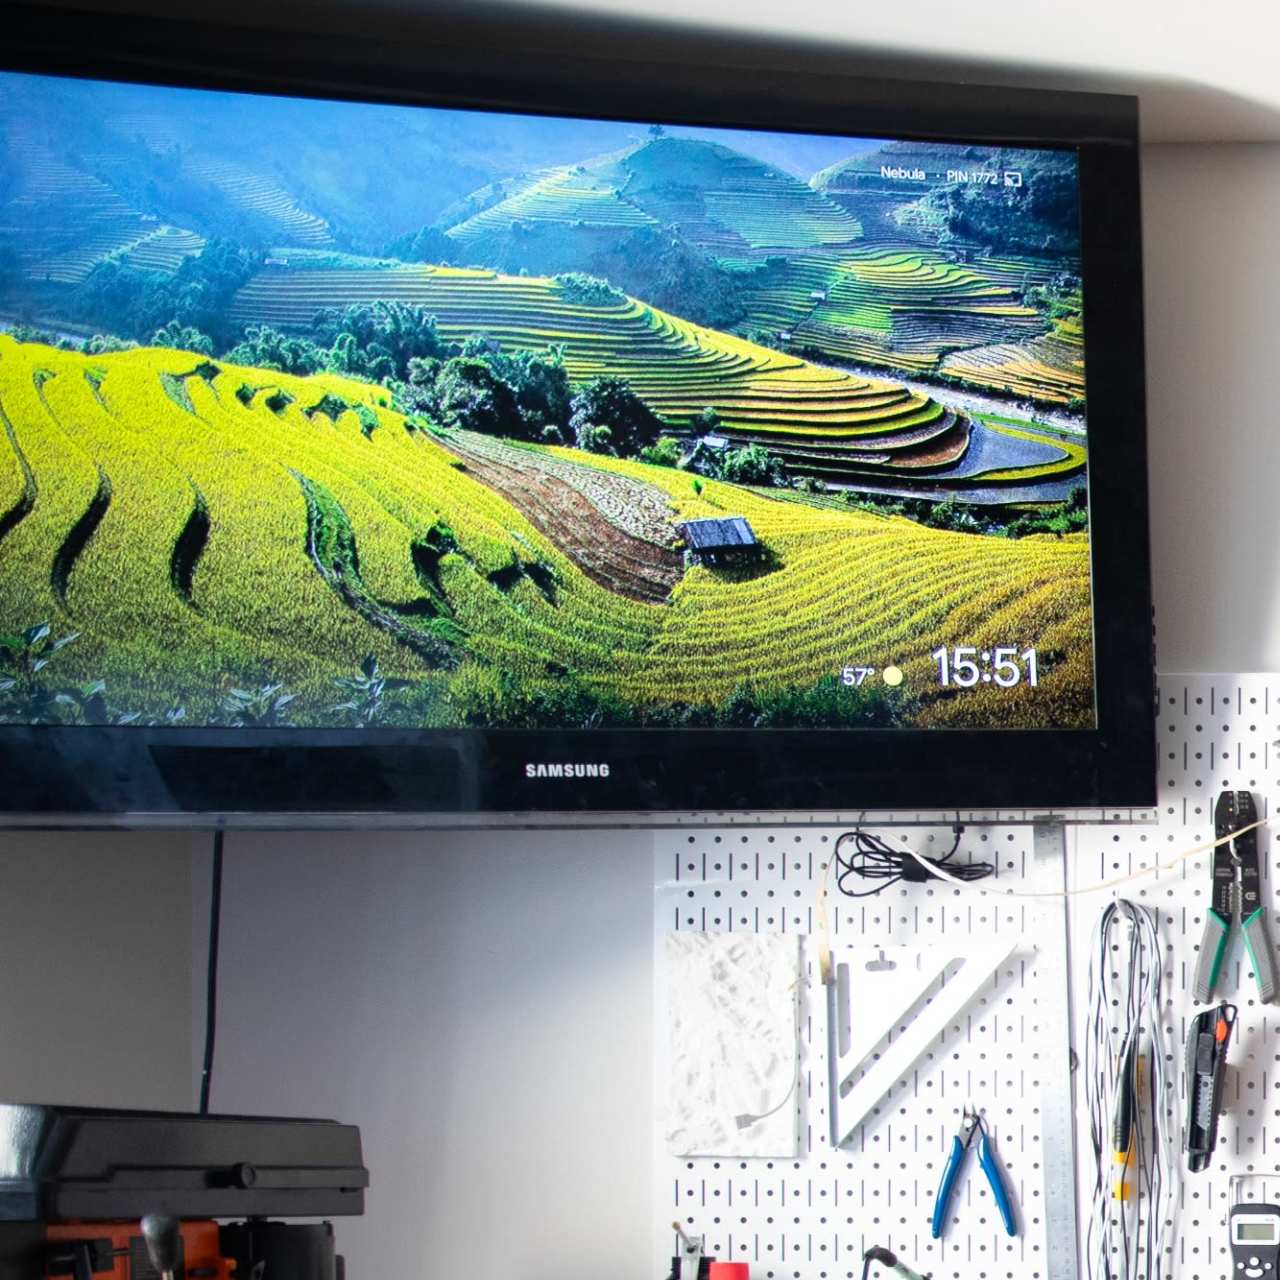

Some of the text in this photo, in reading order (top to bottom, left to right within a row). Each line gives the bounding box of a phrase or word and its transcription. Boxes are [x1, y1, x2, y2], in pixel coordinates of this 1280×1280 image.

[880, 165, 998, 185] Nebula PIN 1772
[932, 646, 1038, 687] 15:51
[525, 763, 610, 778] SAMSUNG
